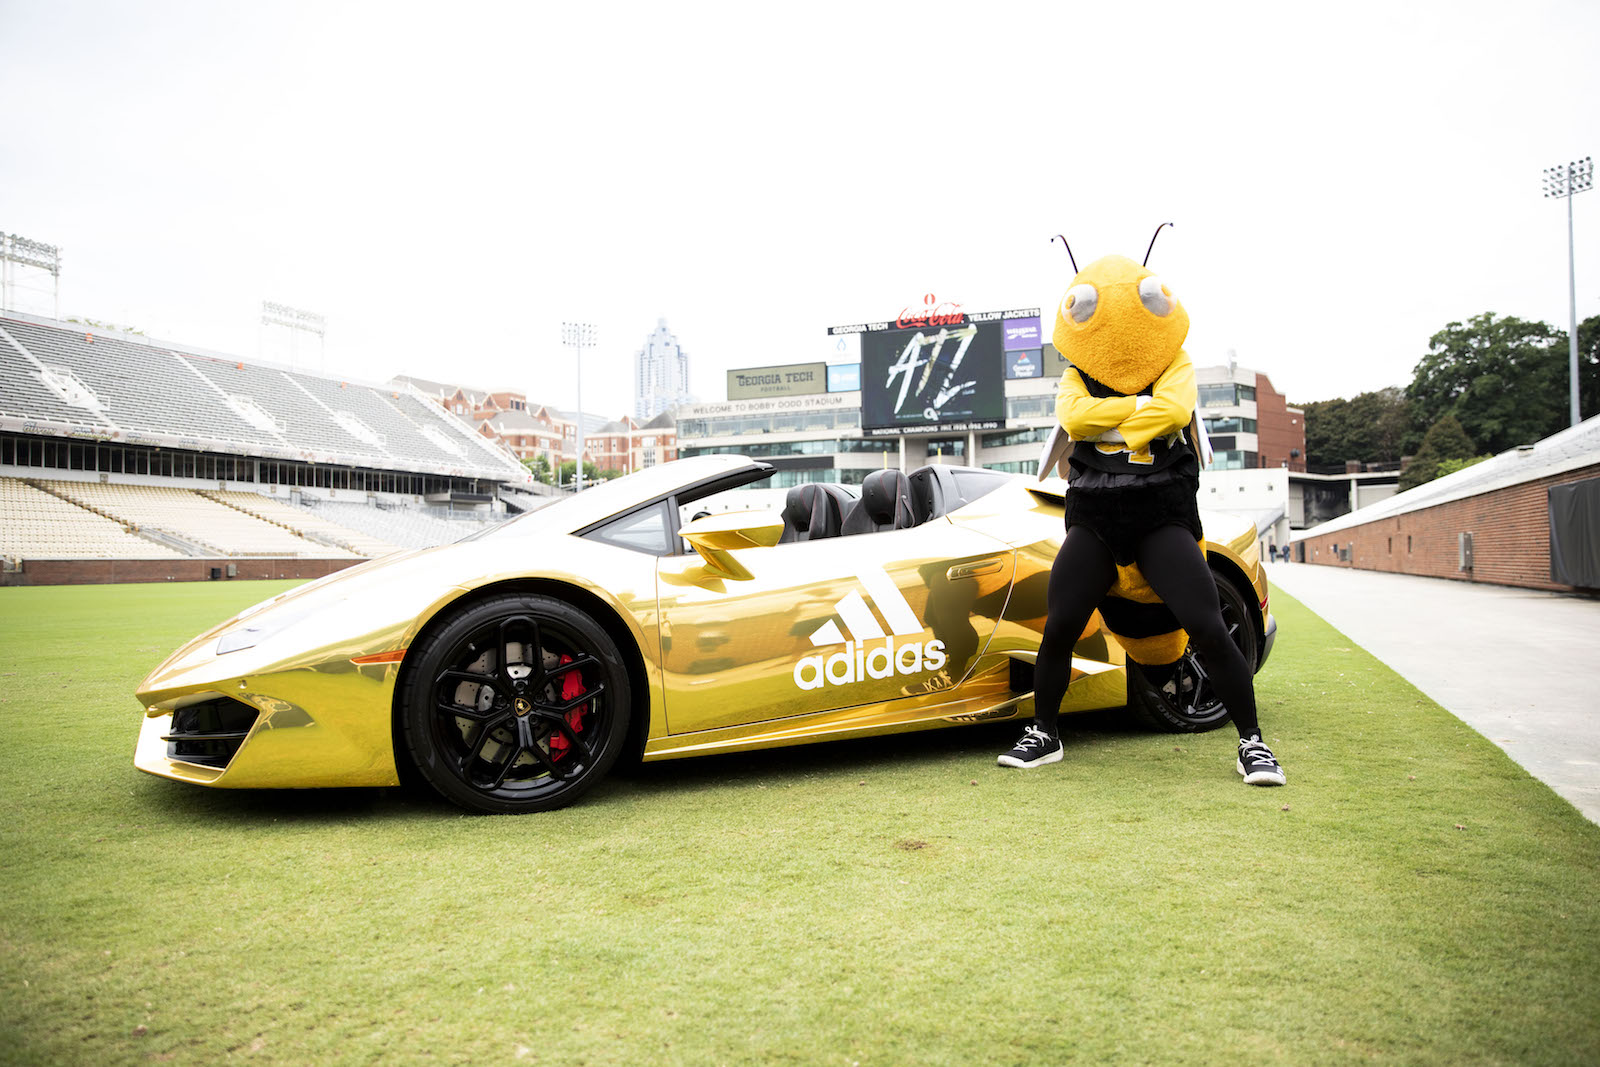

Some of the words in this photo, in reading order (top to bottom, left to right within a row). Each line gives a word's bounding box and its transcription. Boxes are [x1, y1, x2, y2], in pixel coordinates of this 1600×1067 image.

[968, 311, 1001, 323] YELLOW
[1002, 308, 1040, 320] JACKETS
[832, 323, 867, 335] GEORGIA
[867, 322, 888, 332] TECH
[736, 373, 782, 387] GEORGIA
[785, 371, 814, 382] TECH
[760, 385, 791, 393] FOOTBALL
[693, 404, 732, 414] WELCOME
[735, 402, 747, 411] TO
[748, 401, 775, 411] BOBBY
[778, 399, 802, 409] DODD
[805, 396, 843, 406] STADIUM
[903, 425, 938, 434] CHAMPIONS
[793, 635, 946, 690] adidas
